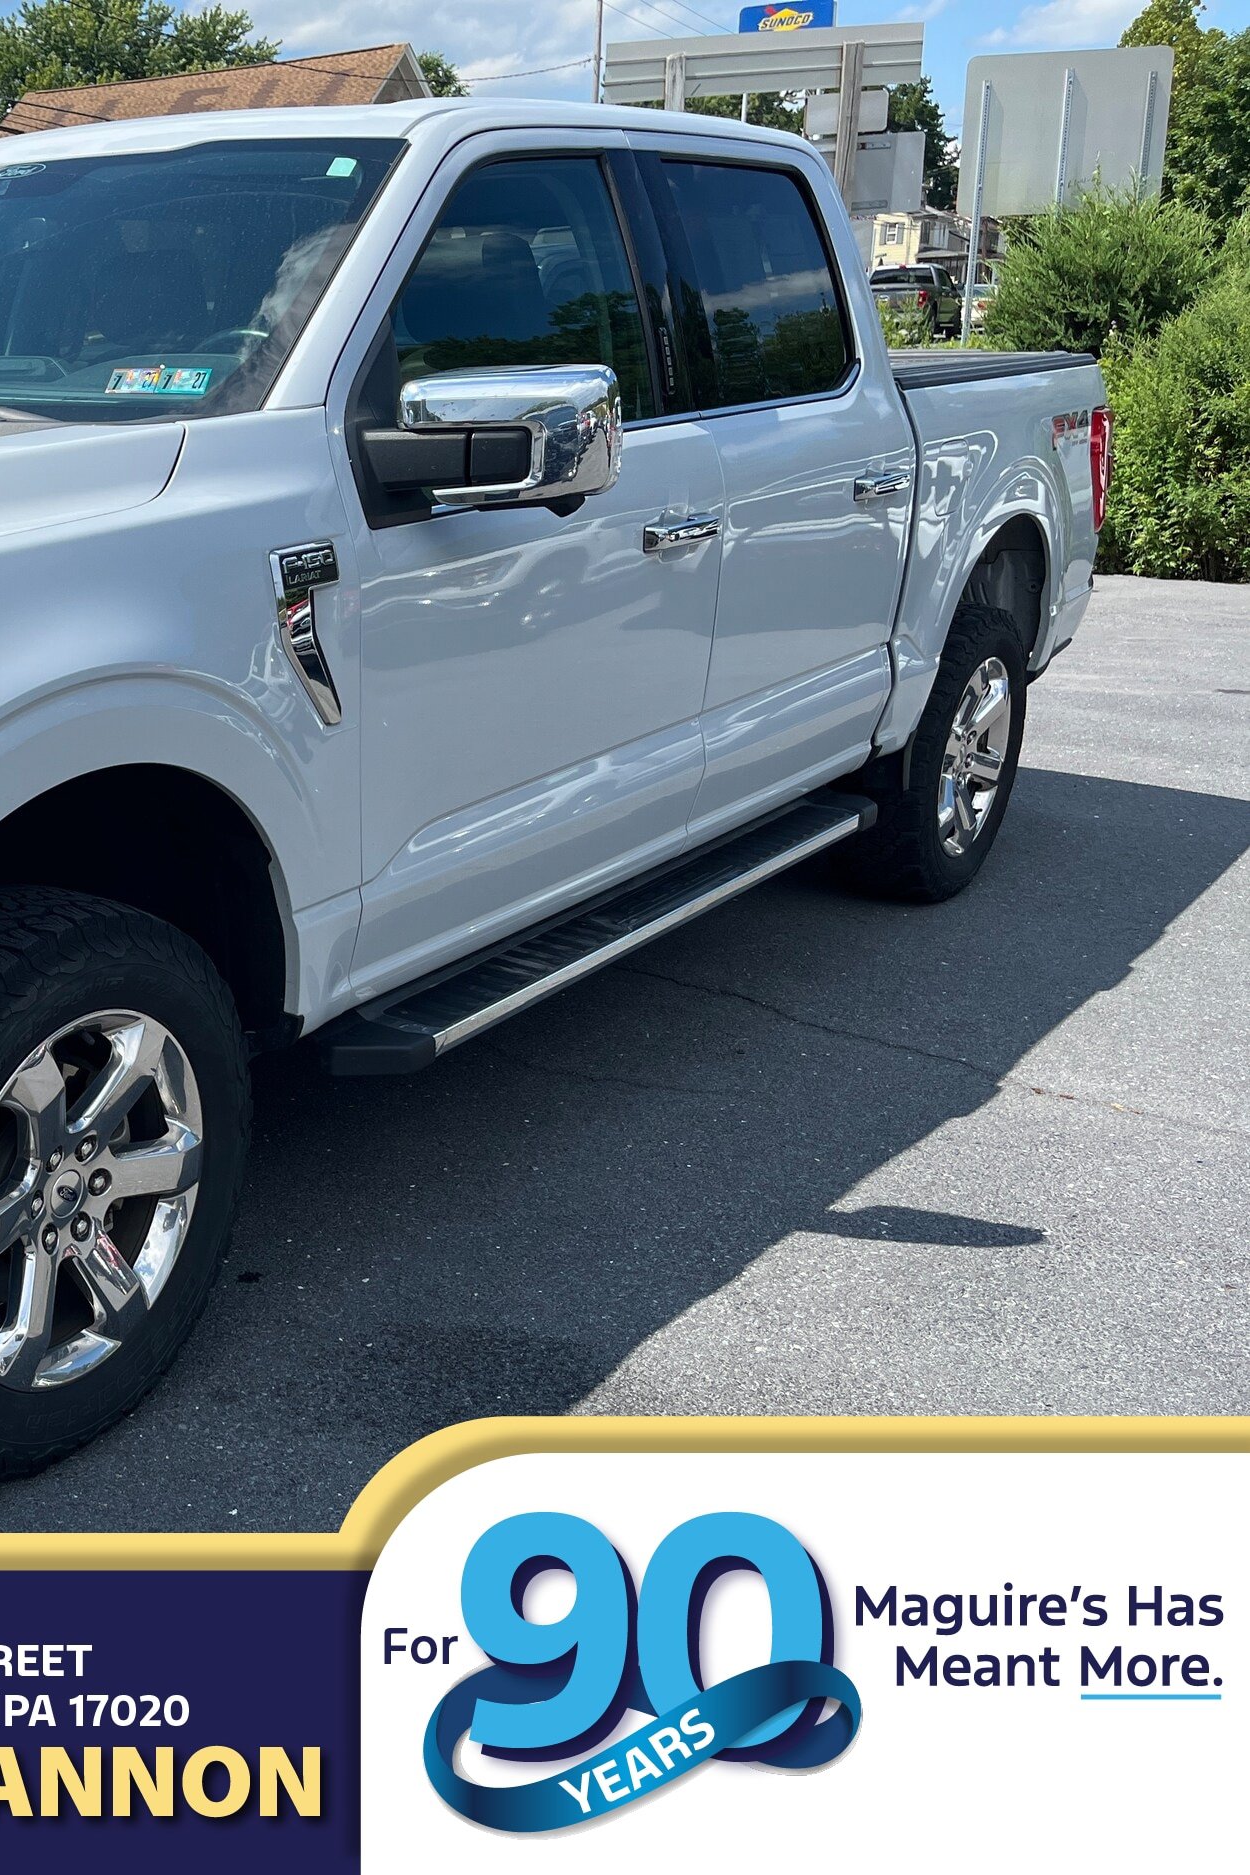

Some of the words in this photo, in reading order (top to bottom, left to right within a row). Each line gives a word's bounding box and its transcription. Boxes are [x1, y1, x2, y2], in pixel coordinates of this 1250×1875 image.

[760, 14, 811, 29] SUNOCO
[191, 371, 207, 389] 27
[282, 549, 336, 574] F-150
[287, 569, 323, 585] LARIAT
